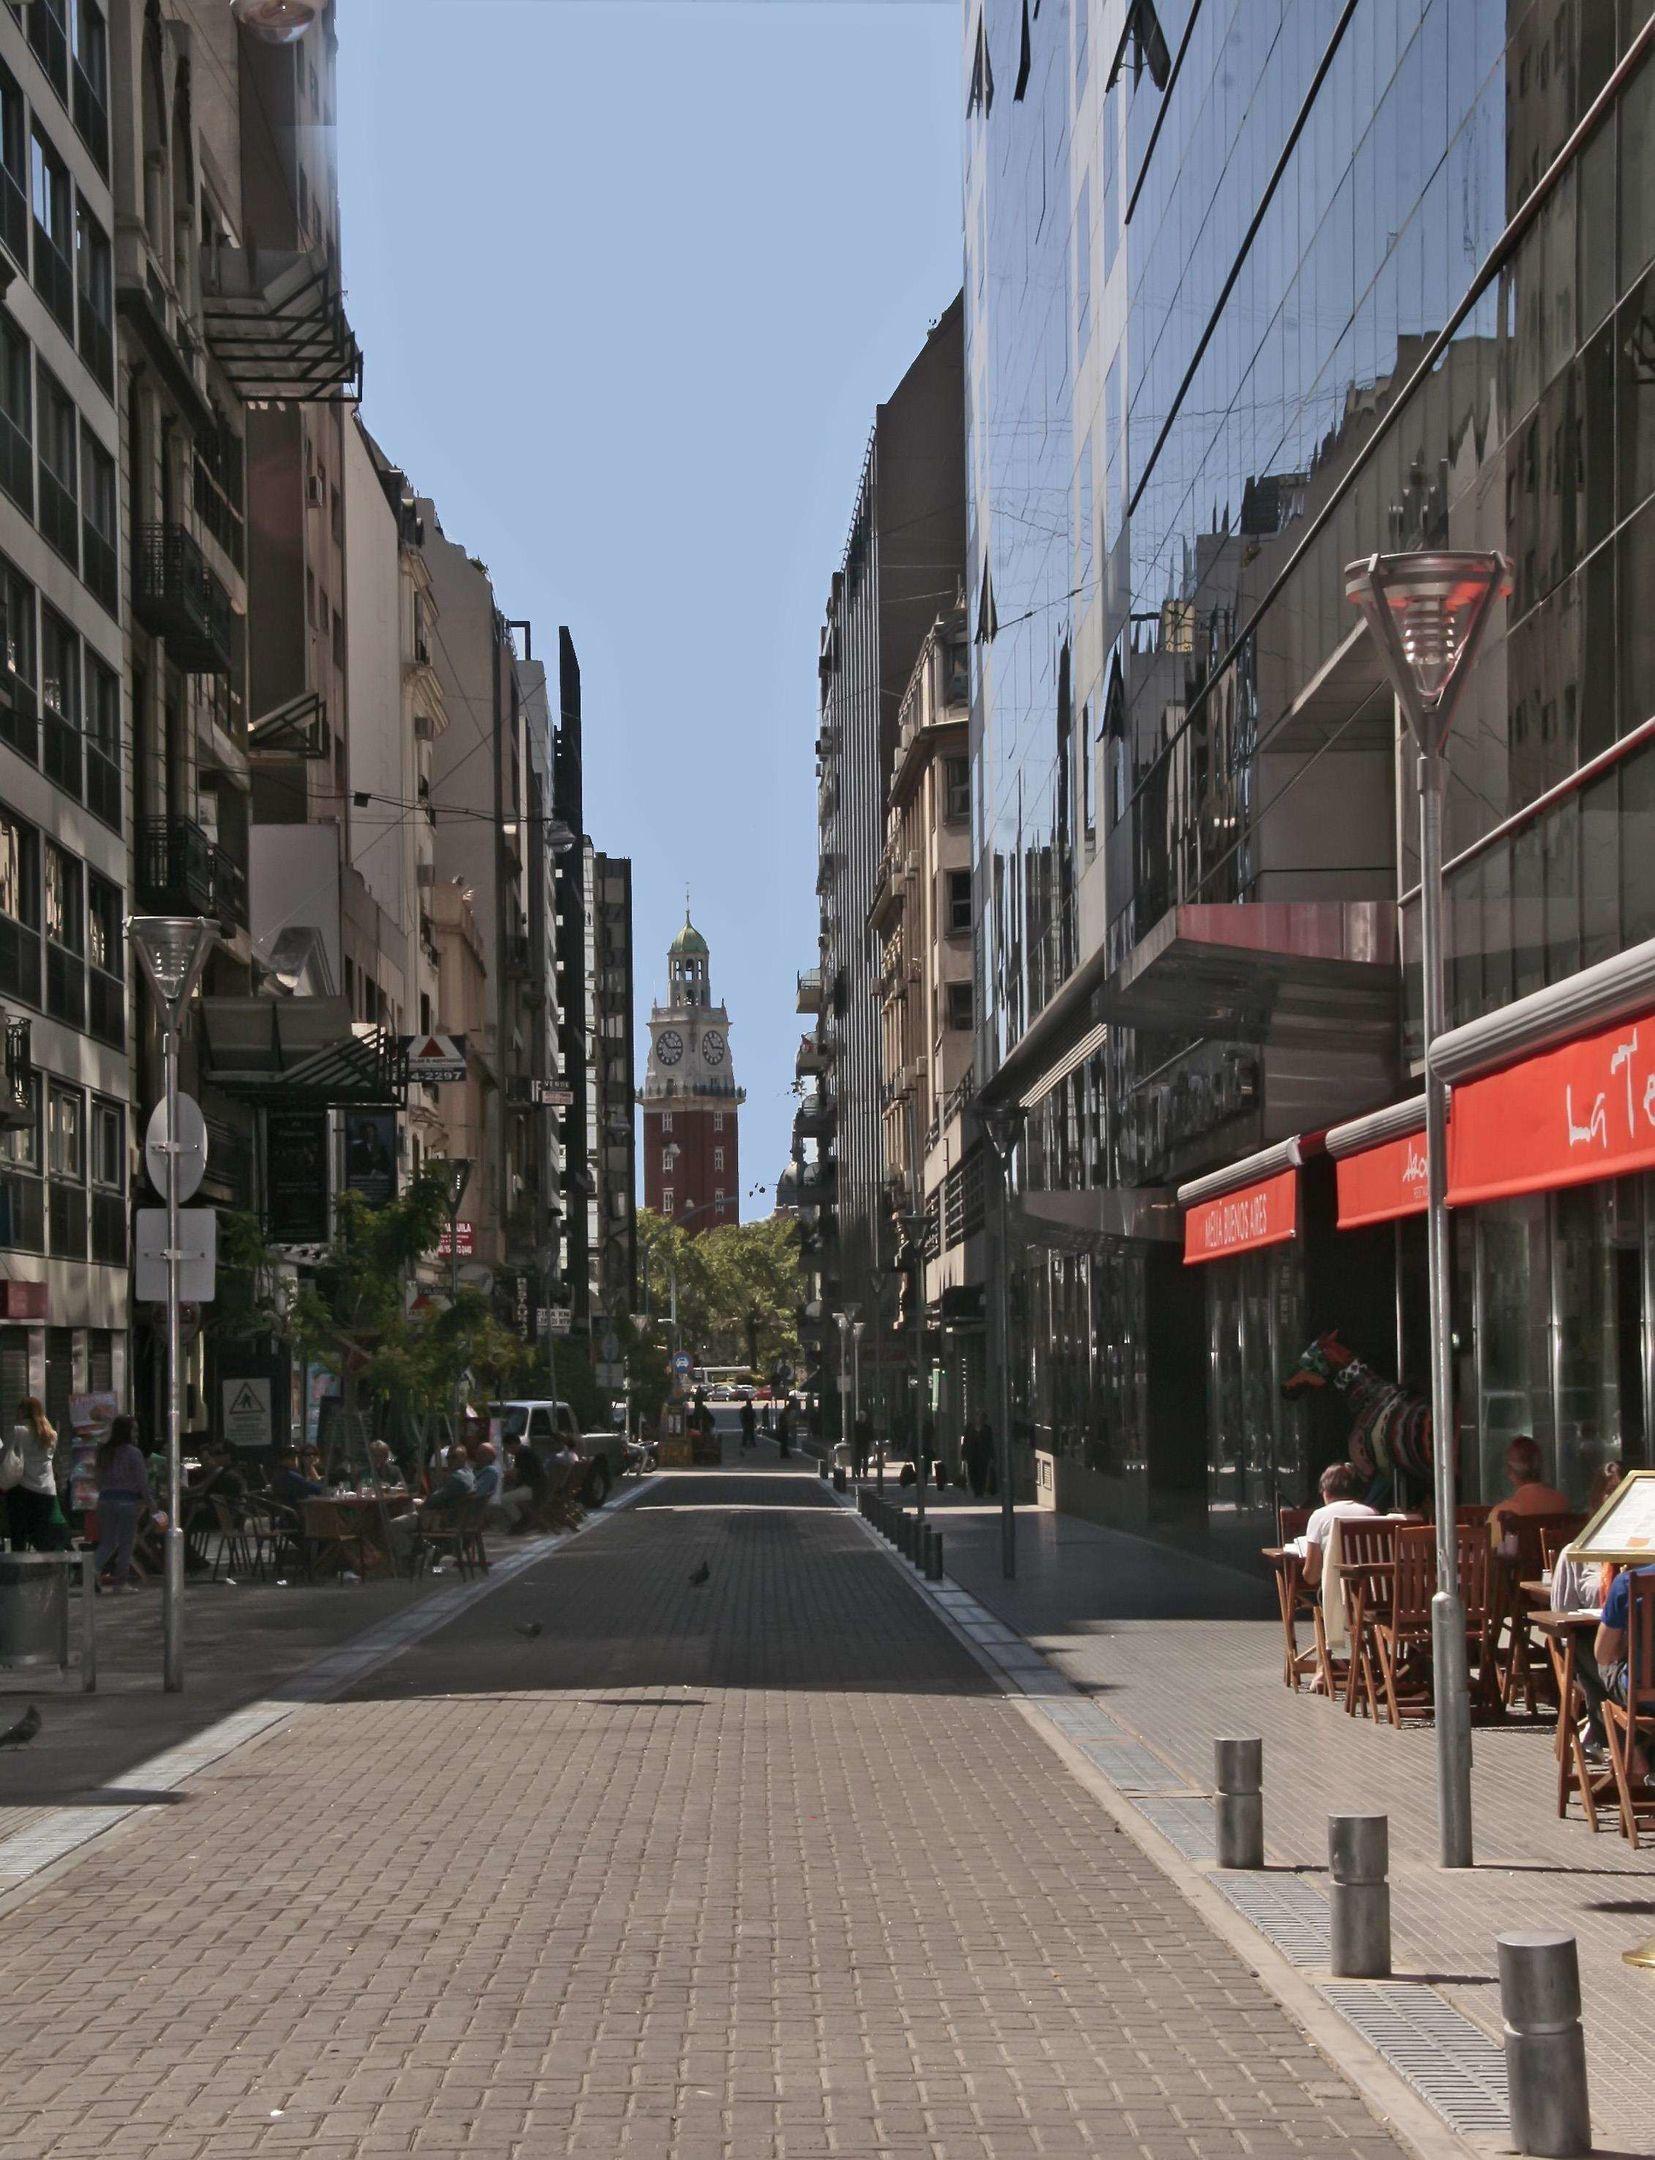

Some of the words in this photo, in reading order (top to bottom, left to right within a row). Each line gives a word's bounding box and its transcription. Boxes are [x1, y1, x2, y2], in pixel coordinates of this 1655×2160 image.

[1566, 1084, 1607, 1149] La
[1223, 1200, 1248, 1245] BUENOS
[1250, 1193, 1267, 1239] AIRES
